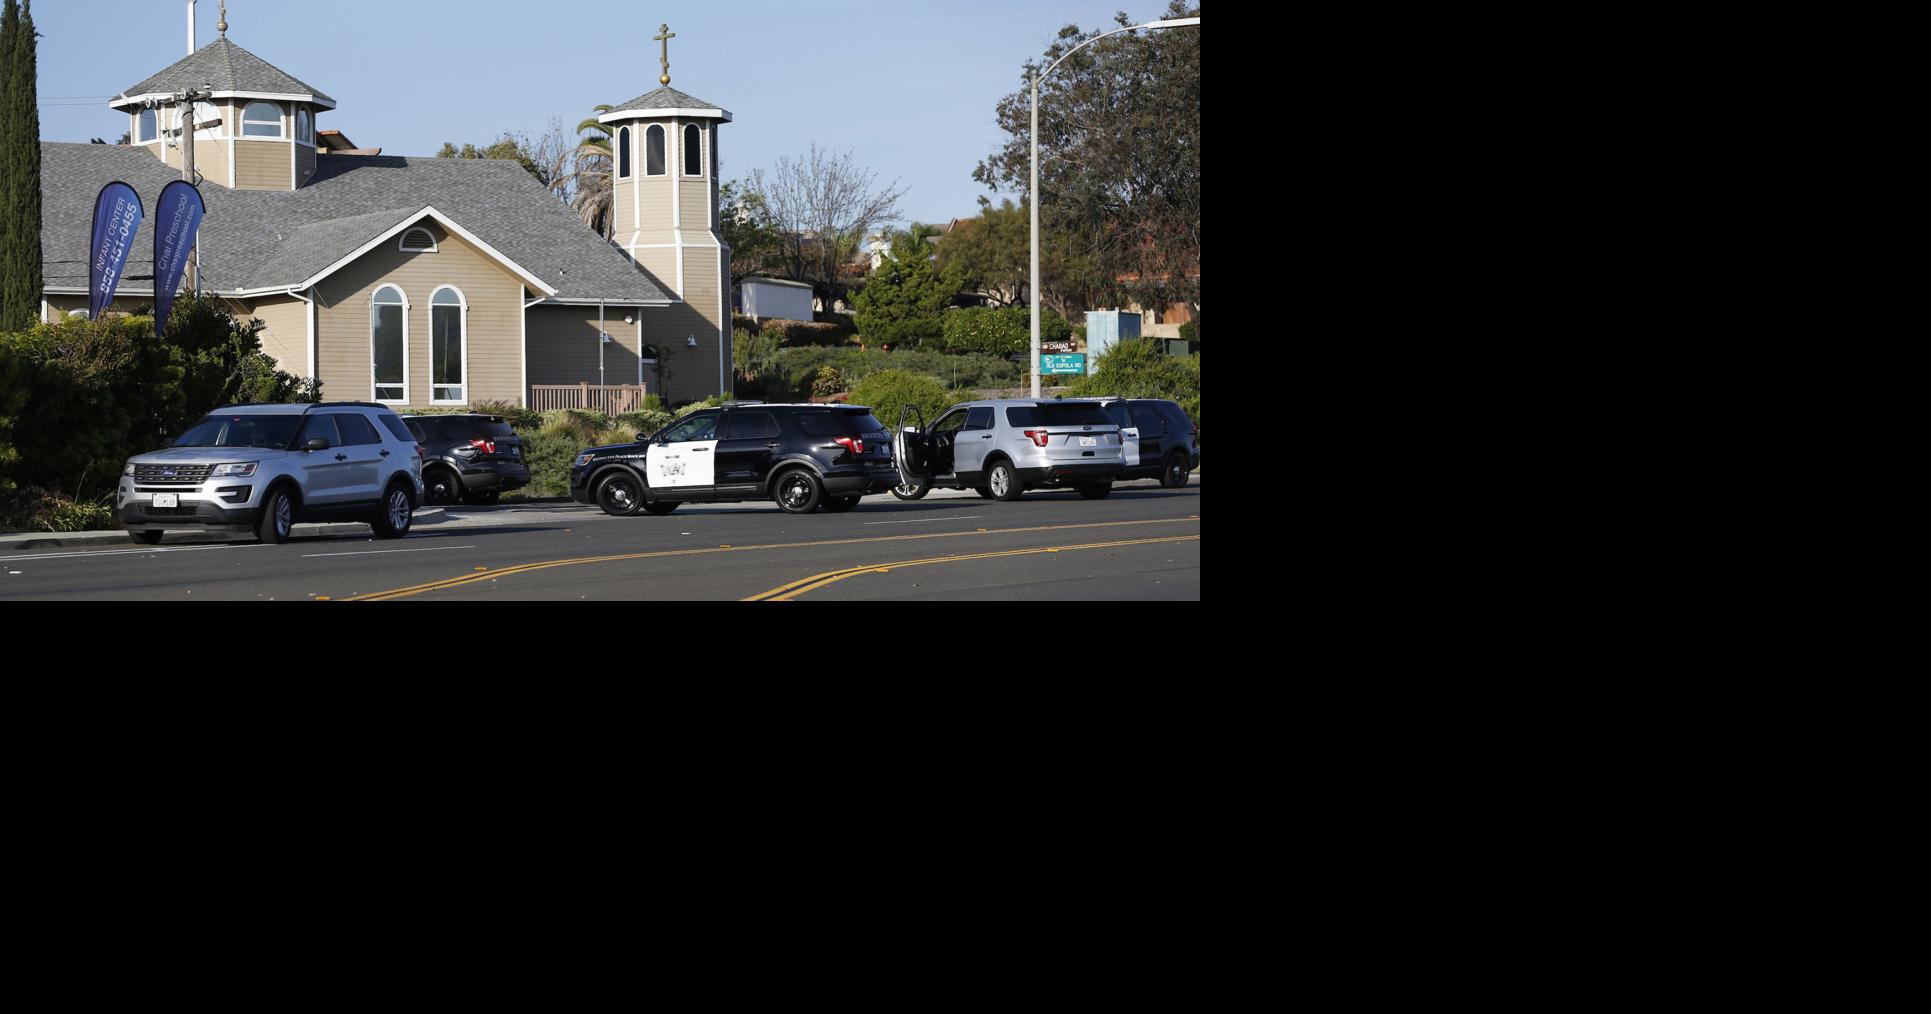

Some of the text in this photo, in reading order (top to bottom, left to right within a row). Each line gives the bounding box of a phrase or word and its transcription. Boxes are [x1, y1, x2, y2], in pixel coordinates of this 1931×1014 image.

[96, 197, 125, 272] INFANT CENTER
[165, 193, 188, 246] Preschool
